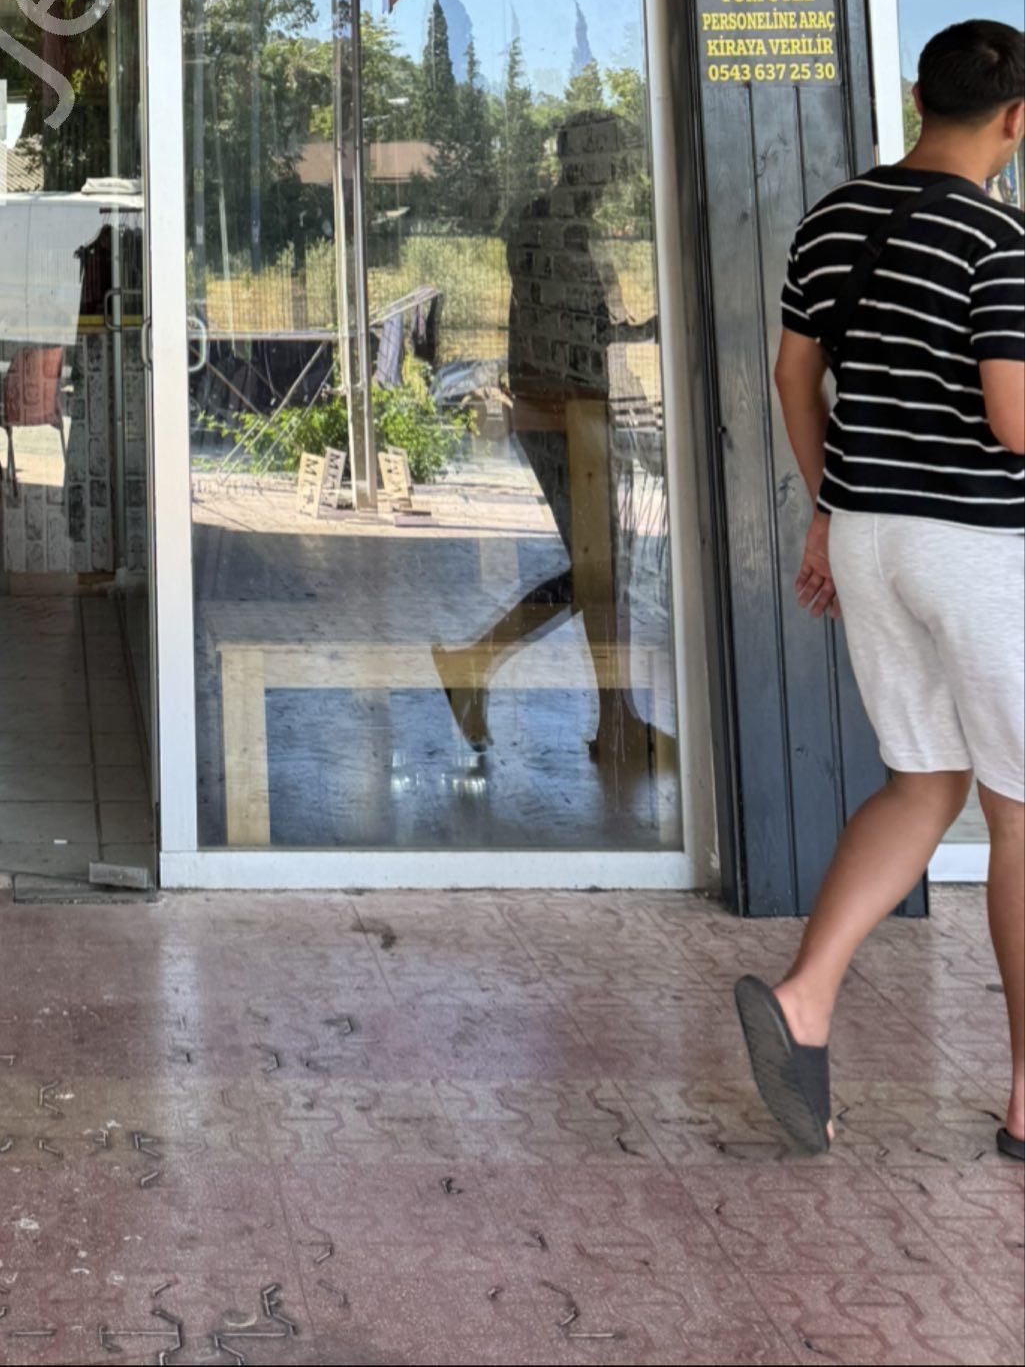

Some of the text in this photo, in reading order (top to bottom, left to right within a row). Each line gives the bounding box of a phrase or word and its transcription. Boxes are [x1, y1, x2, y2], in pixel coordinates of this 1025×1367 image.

[702, 8, 836, 32] PERSONELİNE ARAÇ
[706, 34, 834, 57] KİRAYA VERİLİR
[708, 63, 836, 81] 0543 637 25 30
